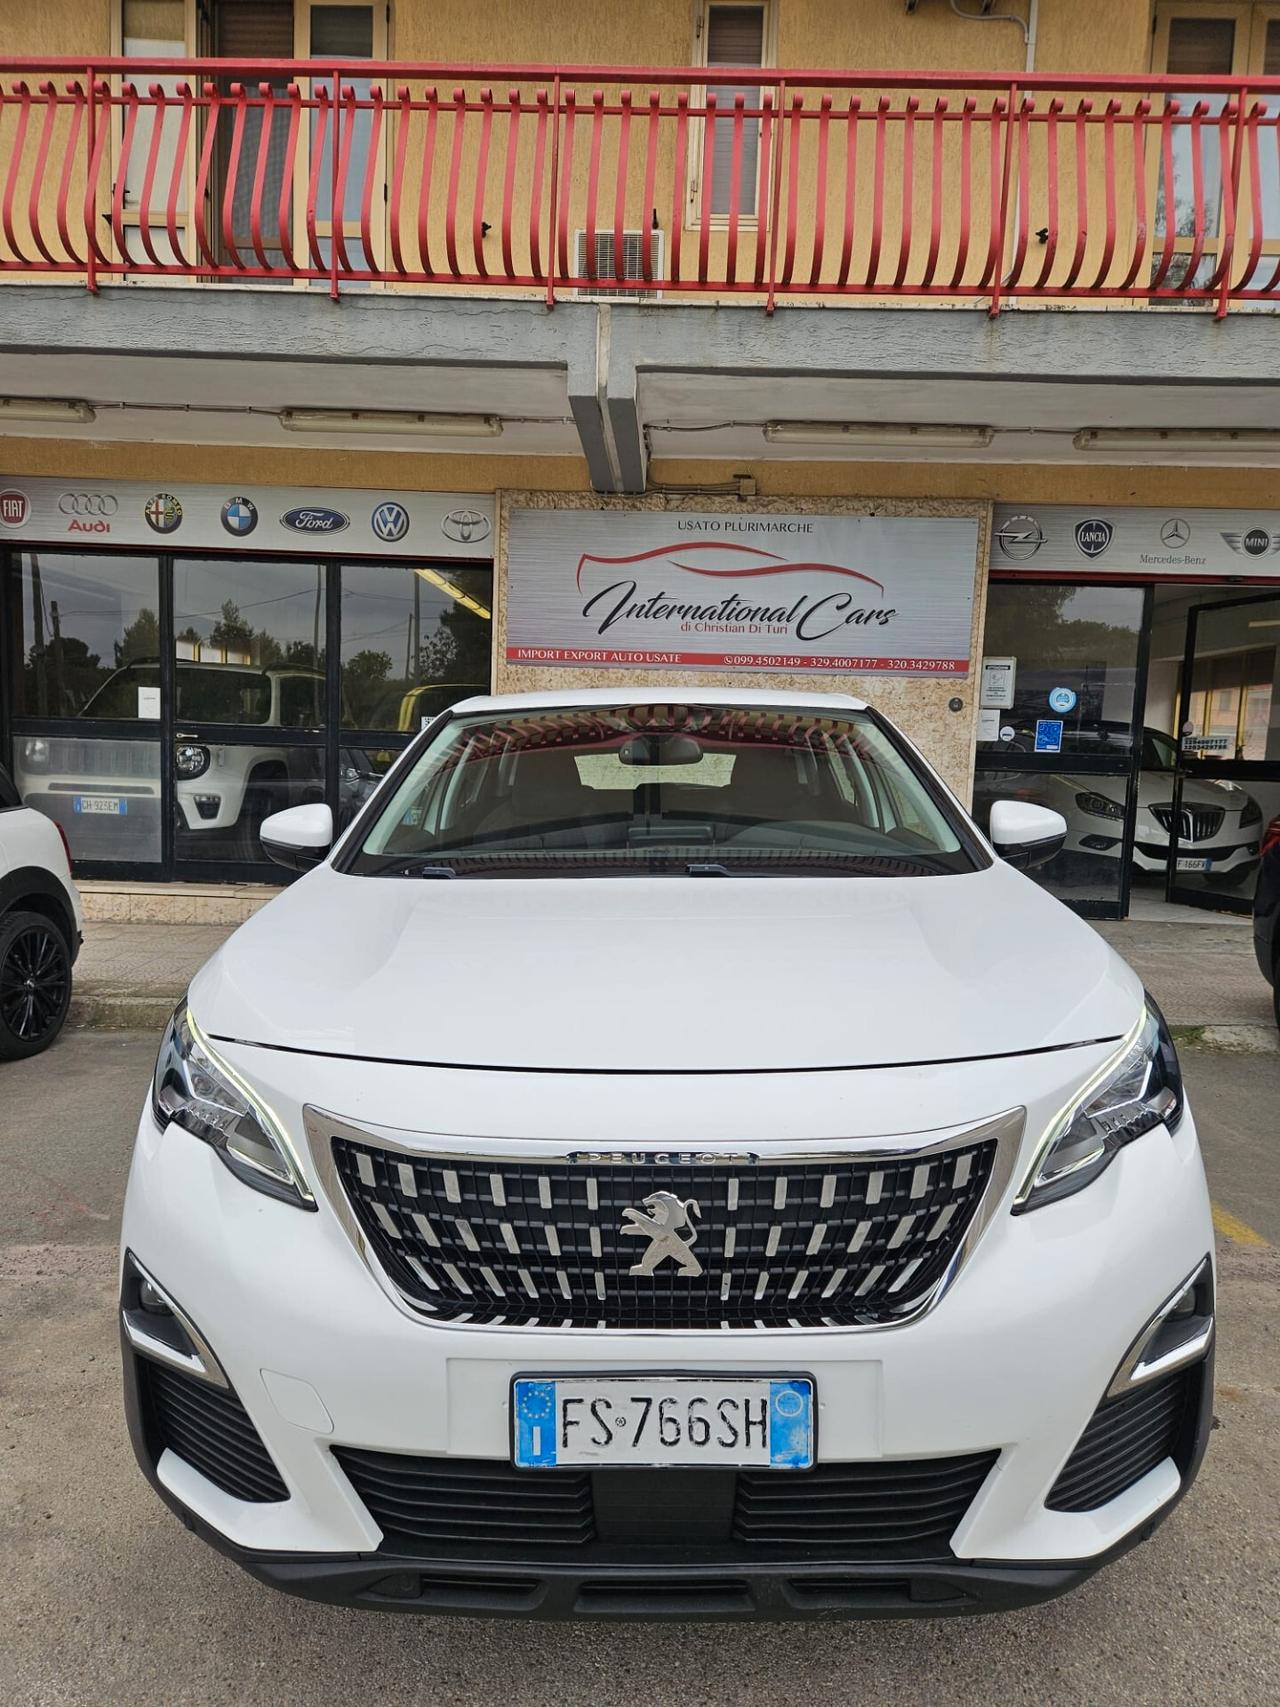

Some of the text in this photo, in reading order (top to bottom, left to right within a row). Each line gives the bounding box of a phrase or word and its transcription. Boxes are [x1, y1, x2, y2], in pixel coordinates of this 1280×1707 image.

[3, 499, 24, 517] FIAT
[68, 519, 111, 533] Audi
[295, 511, 335, 529] Ford
[677, 520, 815, 534] USATO PLURIMARCHE
[1081, 531, 1106, 542] LANCIA
[1245, 537, 1269, 547] MINI
[1139, 553, 1207, 565] Mercedes-Benz
[582, 580, 900, 641] International Cars
[680, 622, 788, 635] di Christian Di Turi
[517, 649, 682, 664] IMPORT EXPORT AUTO USATE
[733, 655, 801, 667] 099.4502149
[810, 658, 878, 669] 329.4007177
[887, 659, 955, 671] 320.3429788
[588, 1152, 738, 1165] PEUGEOT
